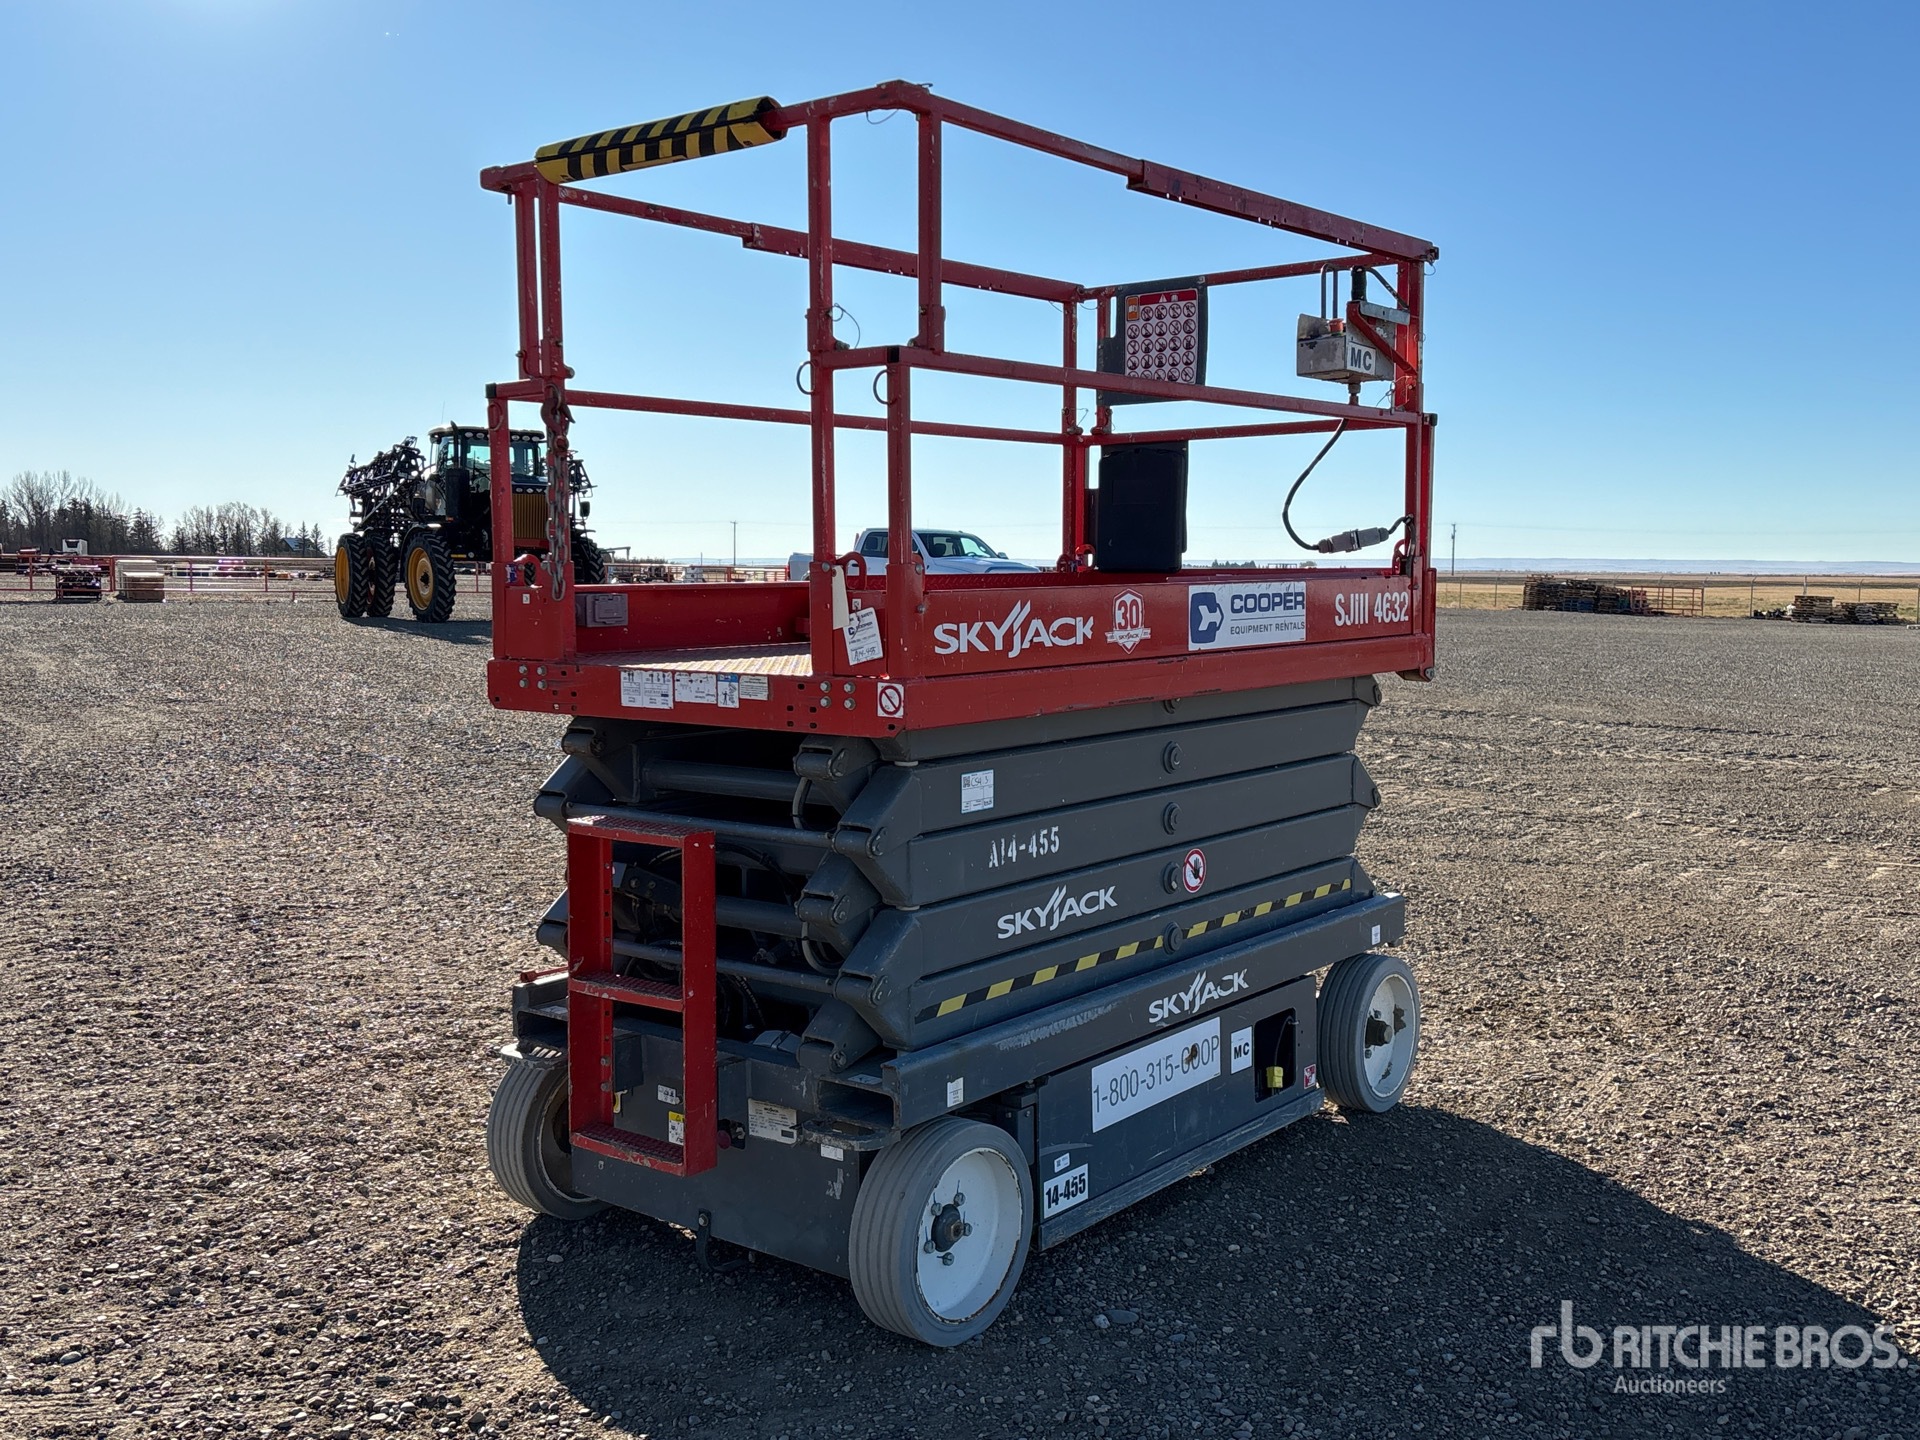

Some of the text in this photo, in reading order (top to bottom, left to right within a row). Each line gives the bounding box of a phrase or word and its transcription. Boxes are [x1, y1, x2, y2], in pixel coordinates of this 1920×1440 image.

[1350, 346, 1372, 371] MC
[1117, 599, 1140, 630] 30
[1231, 591, 1305, 614] COOPER
[1374, 591, 1409, 623] 4632
[933, 600, 1094, 659] SKYJACK
[1230, 621, 1305, 635] EQUIPMENT RENTALS
[989, 826, 1059, 868] A14-455
[997, 885, 1117, 939] SKYJACK
[1148, 968, 1250, 1023] SKYJACK
[1233, 1042, 1250, 1060] MC
[1045, 1172, 1086, 1209] 14-455
